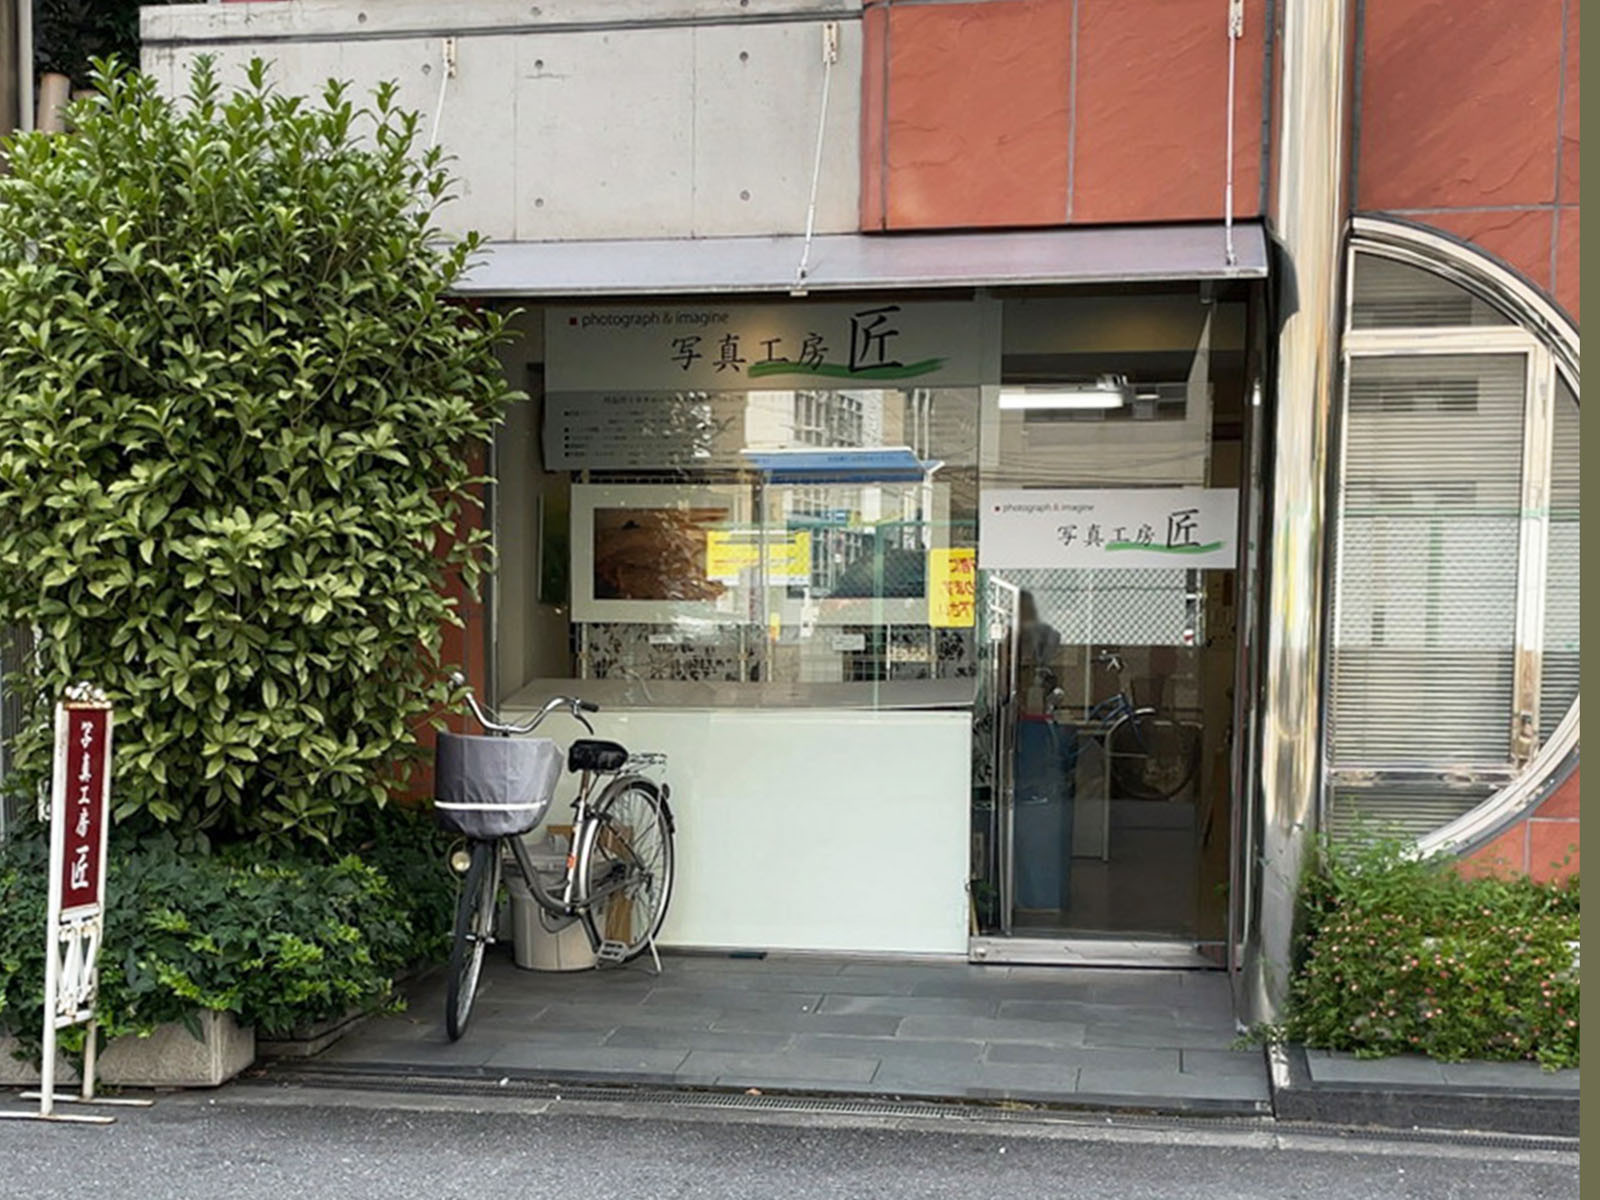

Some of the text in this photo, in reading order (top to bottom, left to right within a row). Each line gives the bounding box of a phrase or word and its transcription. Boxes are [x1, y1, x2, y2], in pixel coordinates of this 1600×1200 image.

[582, 310, 729, 328] photograph & imagine
[1003, 503, 1051, 514] photograph
[1061, 503, 1095, 514] imagine
